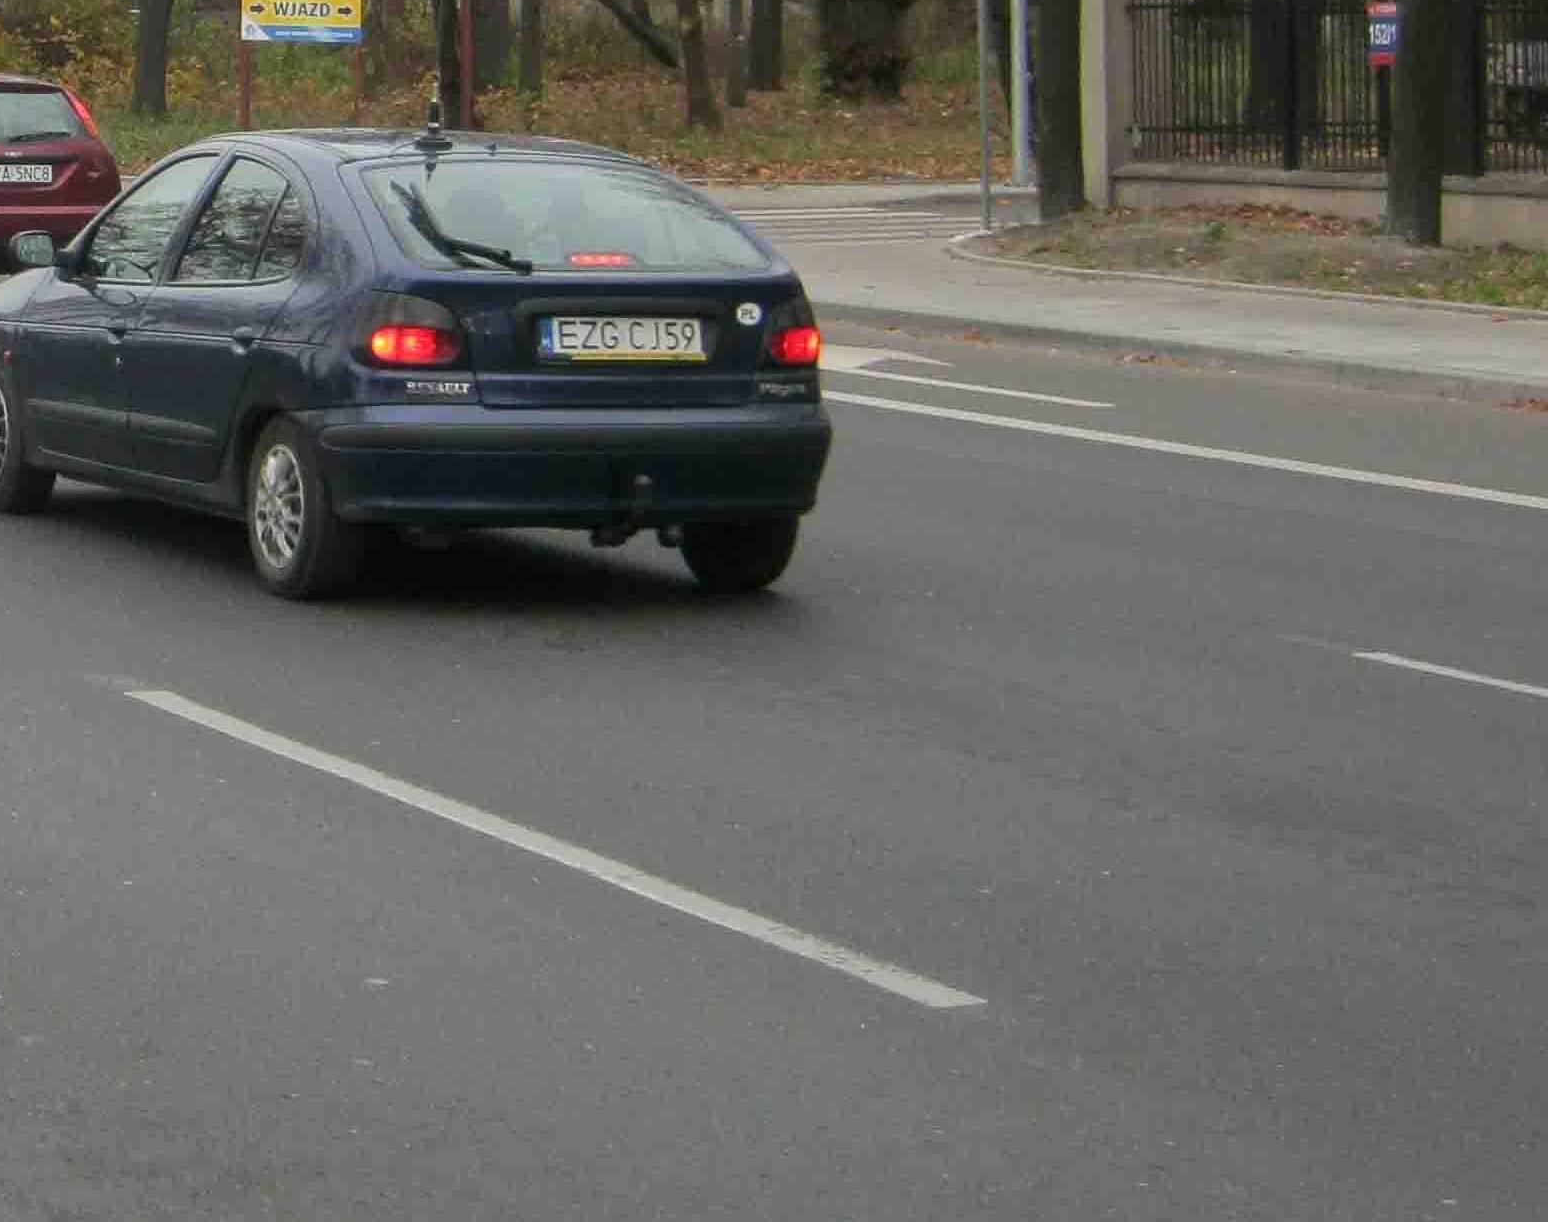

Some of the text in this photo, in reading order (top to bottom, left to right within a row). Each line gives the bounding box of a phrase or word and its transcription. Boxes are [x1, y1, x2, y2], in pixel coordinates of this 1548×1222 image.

[273, 1, 330, 17] WJAZD
[559, 320, 695, 349] EZG CJ59
